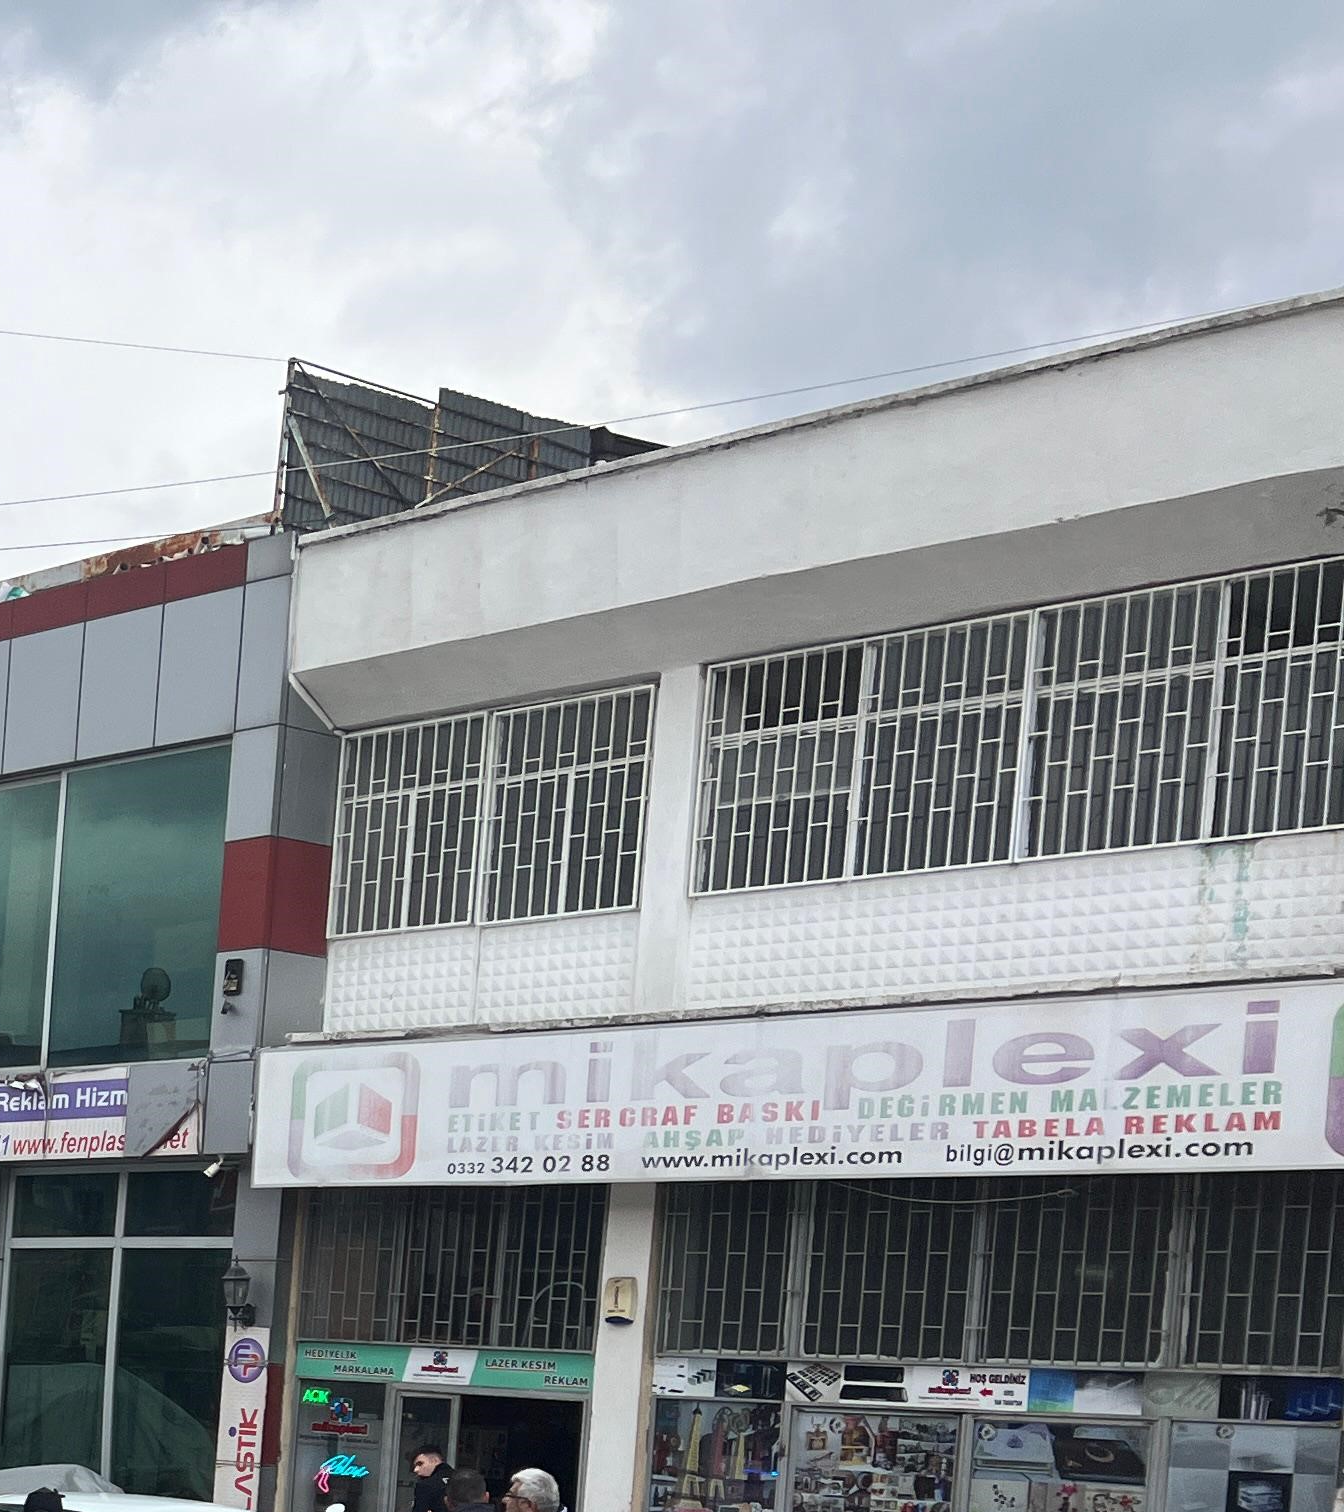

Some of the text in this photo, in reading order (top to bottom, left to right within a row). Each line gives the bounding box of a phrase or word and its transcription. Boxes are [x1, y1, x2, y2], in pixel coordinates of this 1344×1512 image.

[448, 1000, 1280, 1111] mikaplexi
[76, 1087, 127, 1109] Hizm
[716, 1100, 822, 1123] BASKI
[973, 1117, 1105, 1139] TABELA
[1124, 1111, 1283, 1135] REKLAM
[447, 1139, 1254, 1175] 0332 342 02 88 www.mikaplexi.com bilgi@mikaplexi.com
[333, 1363, 394, 1375] MARKALAMA
[485, 1357, 518, 1369] LAZER
[543, 1374, 589, 1386] REKLAM
